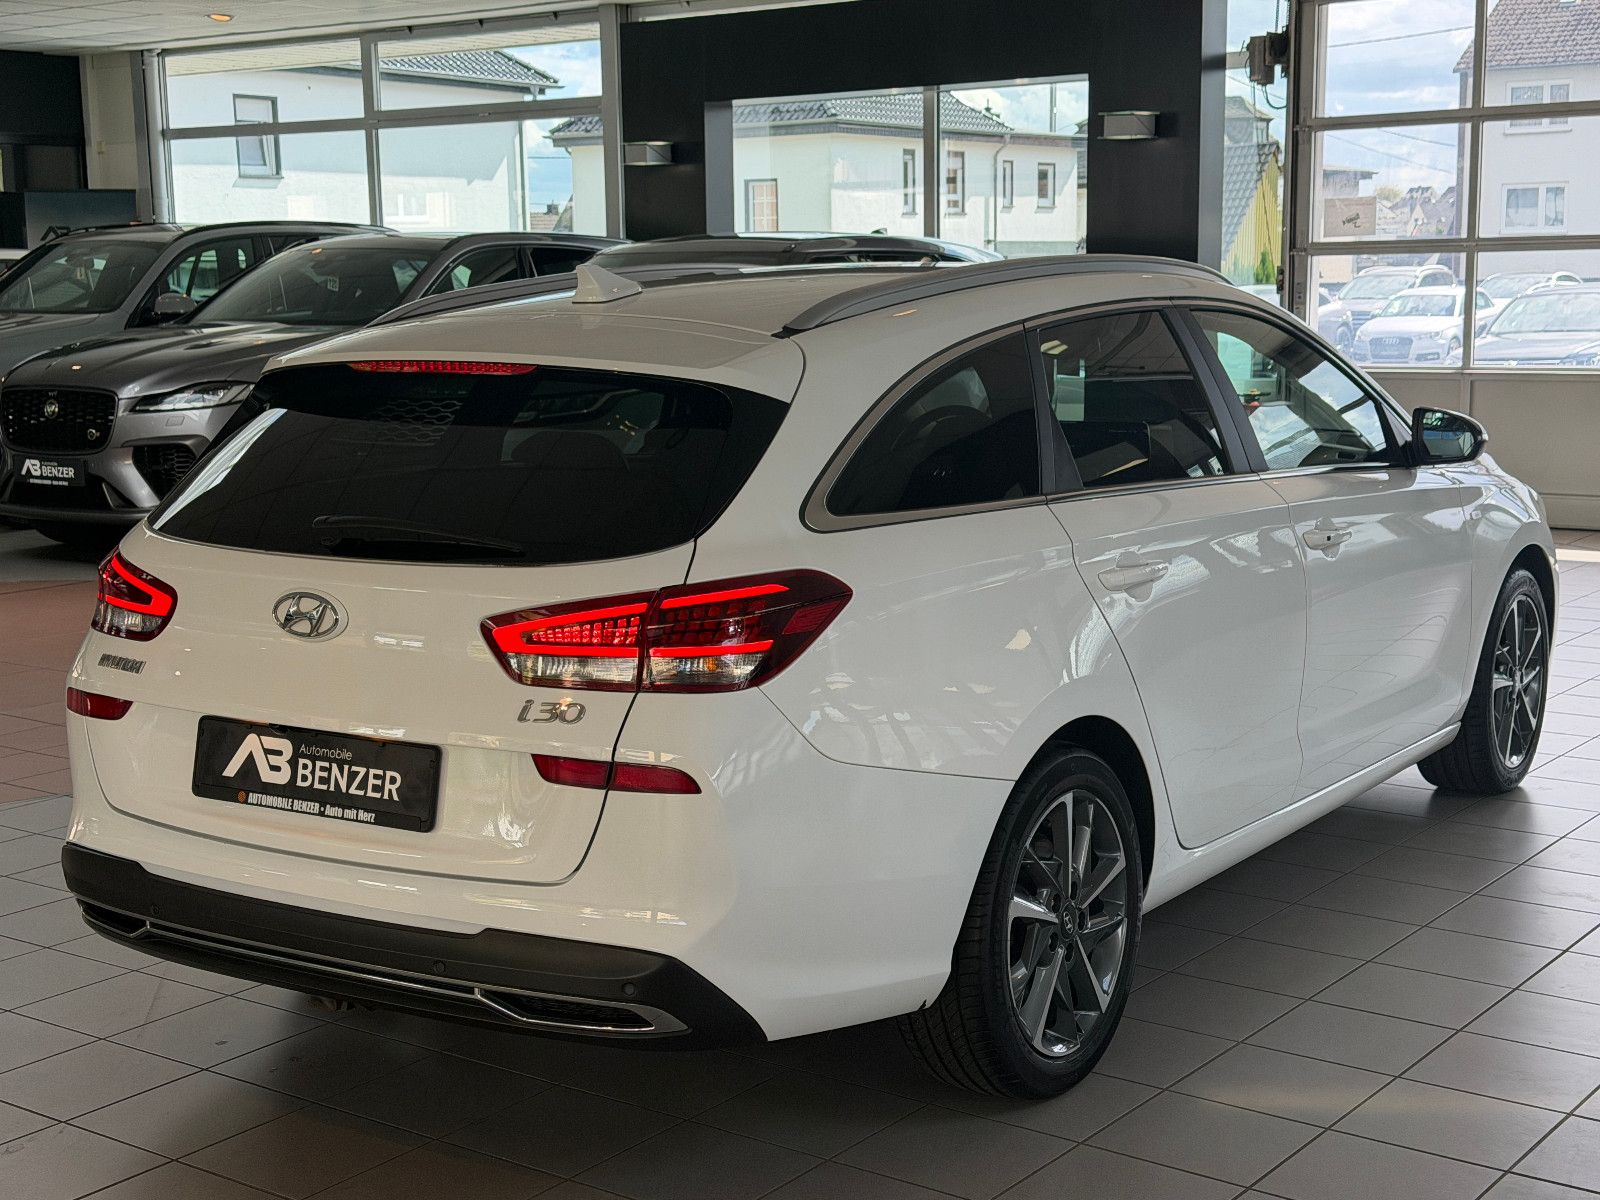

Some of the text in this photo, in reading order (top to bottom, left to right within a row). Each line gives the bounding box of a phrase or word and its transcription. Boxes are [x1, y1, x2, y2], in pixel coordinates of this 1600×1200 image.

[42, 466, 75, 478] BENZER
[517, 699, 586, 725] i30
[222, 733, 293, 785] AB
[299, 743, 353, 761] Automobile
[296, 758, 402, 801] BENZER
[247, 792, 376, 823] AUTOMOBILE BENZER Auto mit Herz
